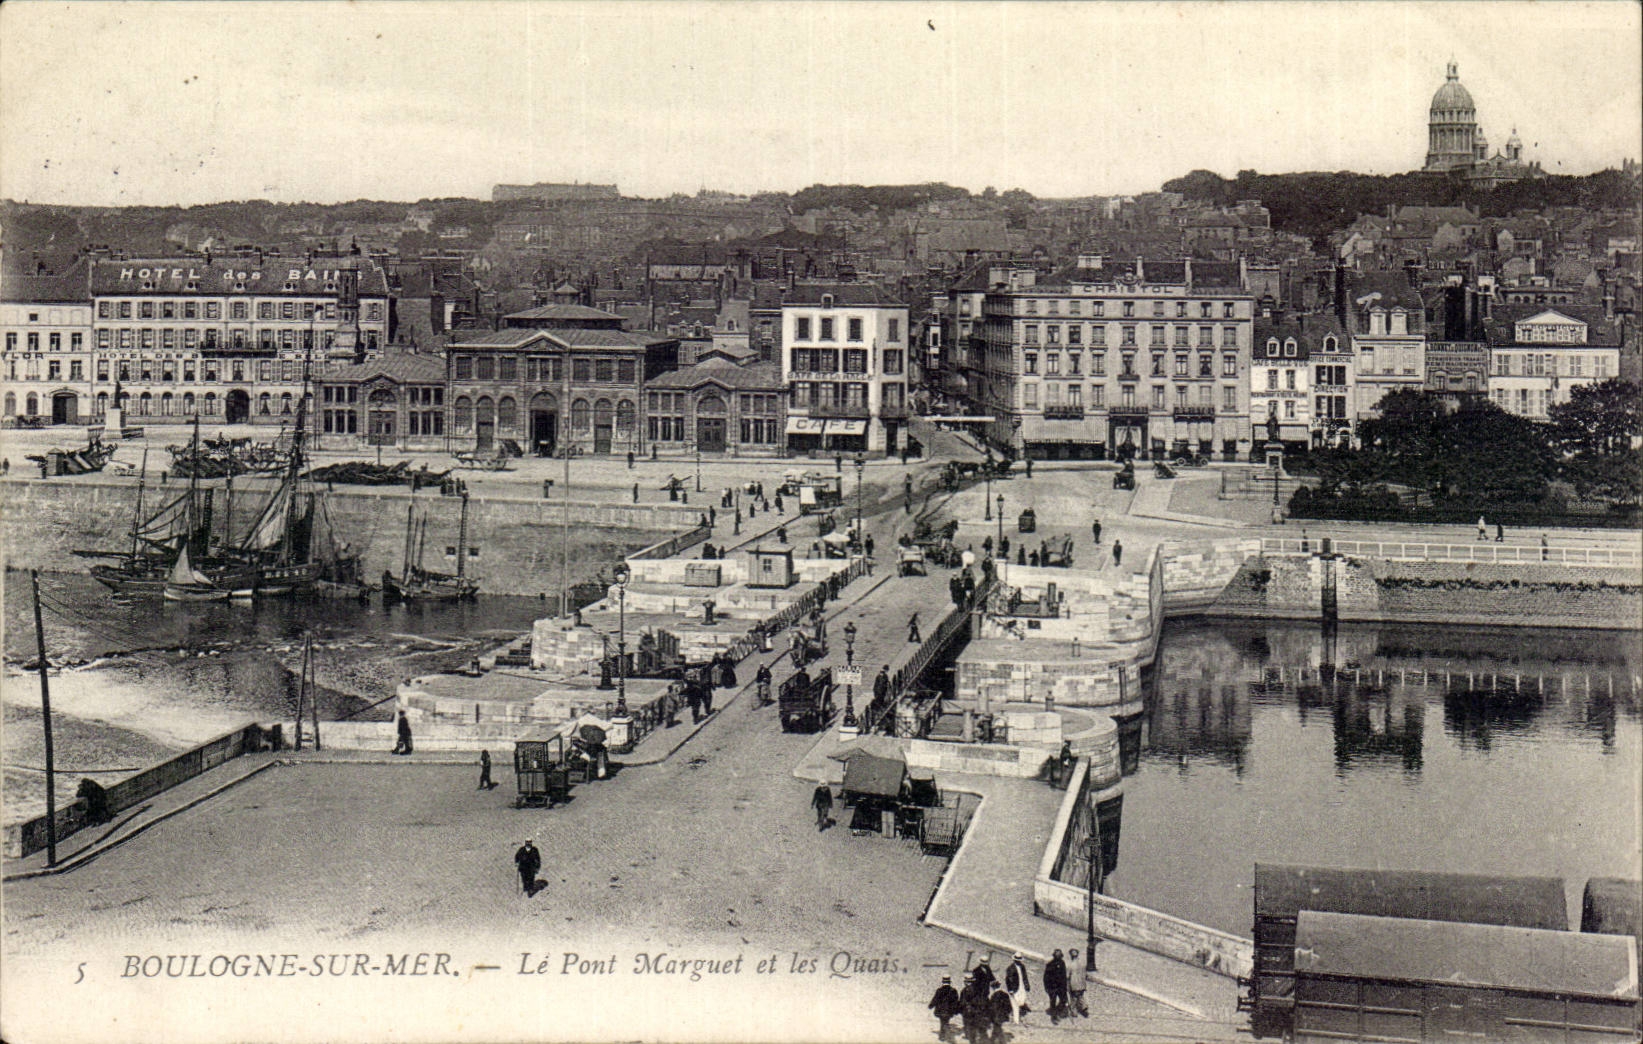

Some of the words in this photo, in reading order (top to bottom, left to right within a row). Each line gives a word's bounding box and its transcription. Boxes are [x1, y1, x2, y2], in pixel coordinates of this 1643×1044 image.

[119, 268, 201, 280] HOTEL
[223, 268, 261, 281] des
[1083, 285, 1173, 294] CHRISTOL
